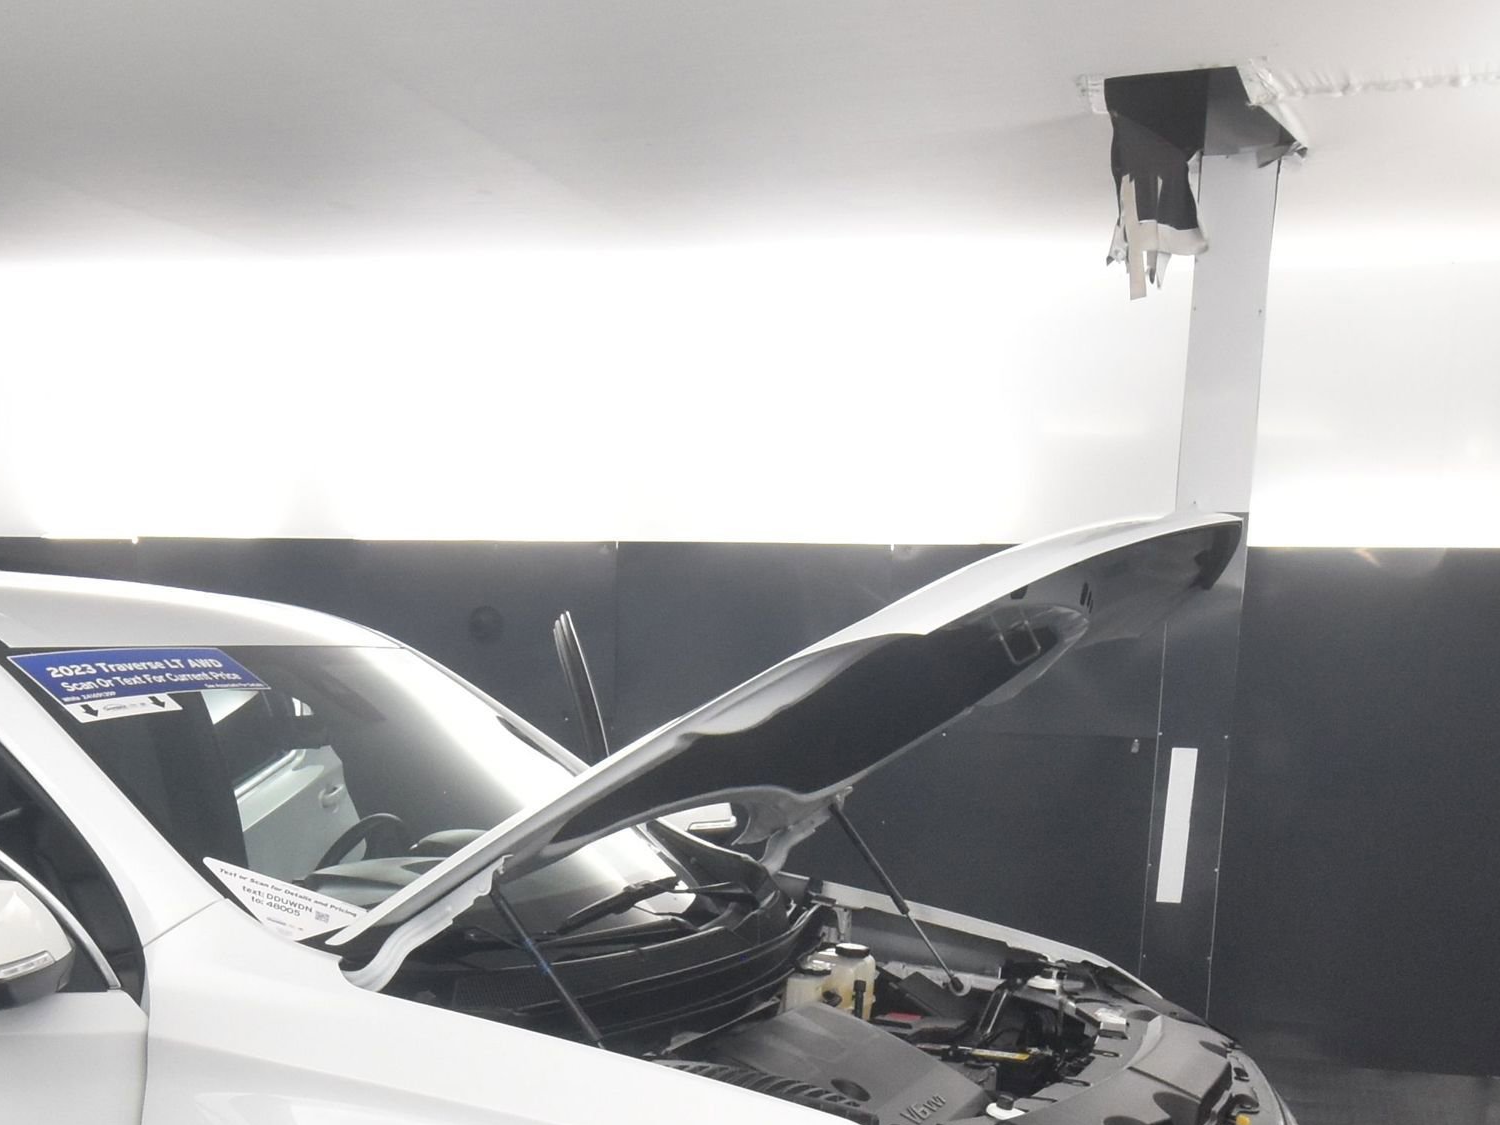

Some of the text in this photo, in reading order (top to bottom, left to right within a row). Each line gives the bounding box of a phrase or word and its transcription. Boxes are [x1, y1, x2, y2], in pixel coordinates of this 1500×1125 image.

[46, 658, 223, 678] 2023 Traverse LT AWD
[61, 671, 242, 692] Scan Or Text For Current Price
[220, 868, 237, 877] Text
[250, 878, 269, 888] Scan
[271, 884, 282, 892] for
[284, 889, 312, 902] Details
[313, 900, 329, 908] and
[330, 904, 357, 917] Pricing
[242, 885, 264, 898] text:
[251, 896, 301, 917] to: 48005
